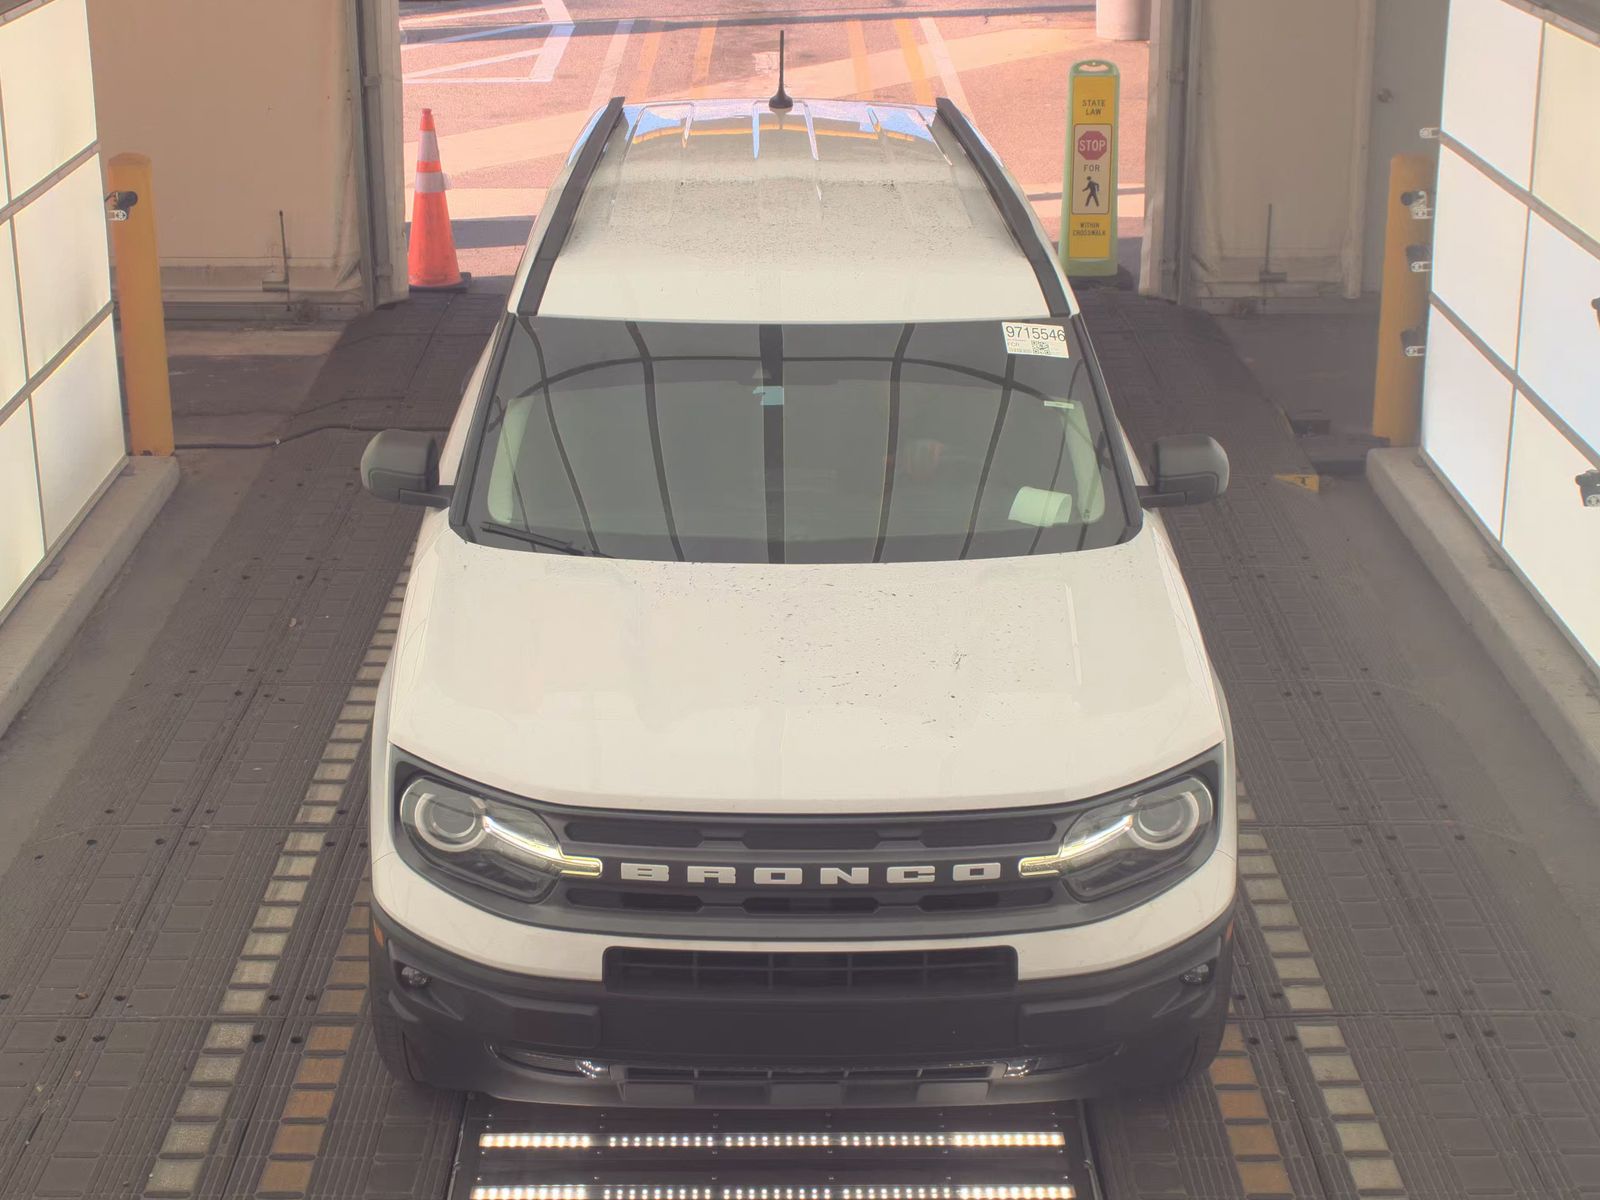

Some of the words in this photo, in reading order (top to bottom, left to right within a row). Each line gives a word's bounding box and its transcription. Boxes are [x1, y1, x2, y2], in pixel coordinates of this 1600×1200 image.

[1082, 99, 1106, 107] STATE
[1085, 108, 1102, 116] LAW
[1078, 139, 1106, 152] STOP
[1083, 164, 1101, 173] FOR
[1005, 325, 1067, 342] 9715546
[620, 861, 1001, 885] BRONCO
